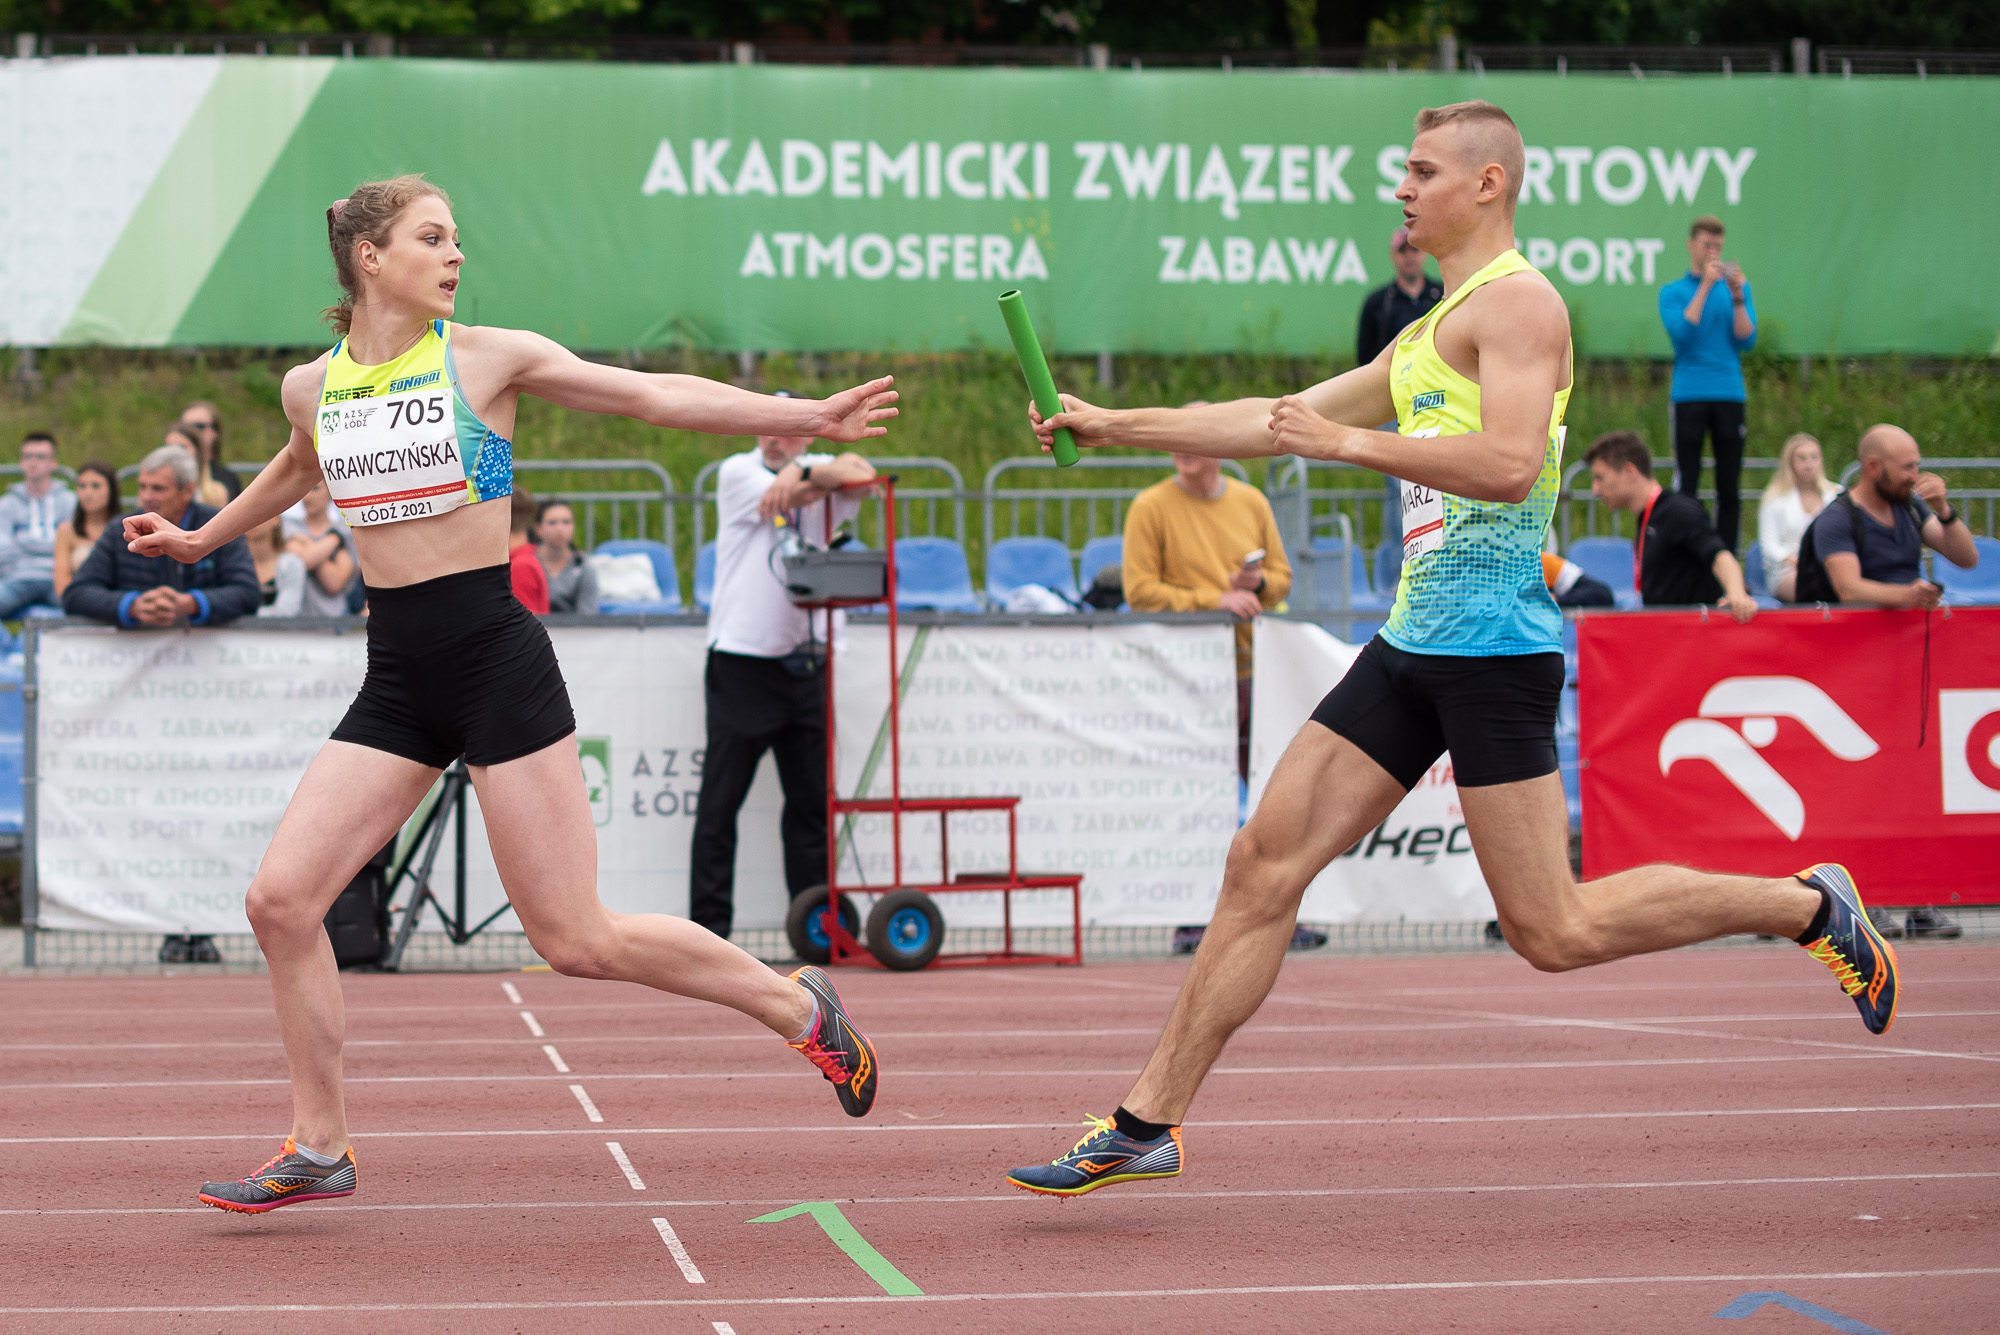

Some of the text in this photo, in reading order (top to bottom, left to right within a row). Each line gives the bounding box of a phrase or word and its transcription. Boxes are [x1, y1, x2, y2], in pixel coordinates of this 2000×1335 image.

[641, 138, 1758, 220] AKADEMICKI ZWIĄZEK SRTOWY
[740, 231, 1050, 281] ATMOSFERA
[1158, 236, 1369, 284] ZABAWA
[389, 371, 442, 393] SONAROL
[344, 409, 363, 420] AZS
[387, 396, 445, 430] 705
[324, 440, 458, 482] KRAWCZYŃSKA
[361, 503, 399, 524] ŁÓDŹ
[401, 501, 434, 518] 2021
[219, 646, 312, 667] ZABAWA
[922, 639, 1233, 663] ABAWA SPORT ATMOSFER
[43, 680, 359, 700] SPORT ATMOSFERA ZABAW
[907, 676, 976, 697] SFERA
[1096, 675, 1169, 696] SPORT
[162, 720, 254, 739] ZABAWA
[281, 721, 337, 739] SPO
[901, 714, 954, 734] AWA
[966, 712, 1040, 733] SPORT
[75, 754, 212, 772] ATMOSFERA
[228, 754, 308, 772] ZABAW
[632, 749, 705, 778] AZS
[935, 747, 1029, 767] ZABAWA
[1042, 745, 1116, 766] SPORT
[1128, 744, 1233, 766] ATMOSFE
[66, 788, 141, 806] SPORT
[990, 779, 1081, 799] ZABAWA
[1090, 778, 1164, 798] SPORT
[632, 784, 699, 816] ŁÓD
[44, 821, 107, 840] BAWA
[130, 821, 206, 840] SPORT
[922, 814, 1058, 834] AMOSERA
[1073, 812, 1164, 832] ZABAWA
[1042, 848, 1116, 868] SPORT
[1127, 847, 1227, 868] ATMOSF
[44, 861, 83, 879] ORT
[97, 861, 234, 880] ATMOSFERA
[170, 894, 245, 911] ATMOS
[1121, 883, 1195, 902] SPORT
